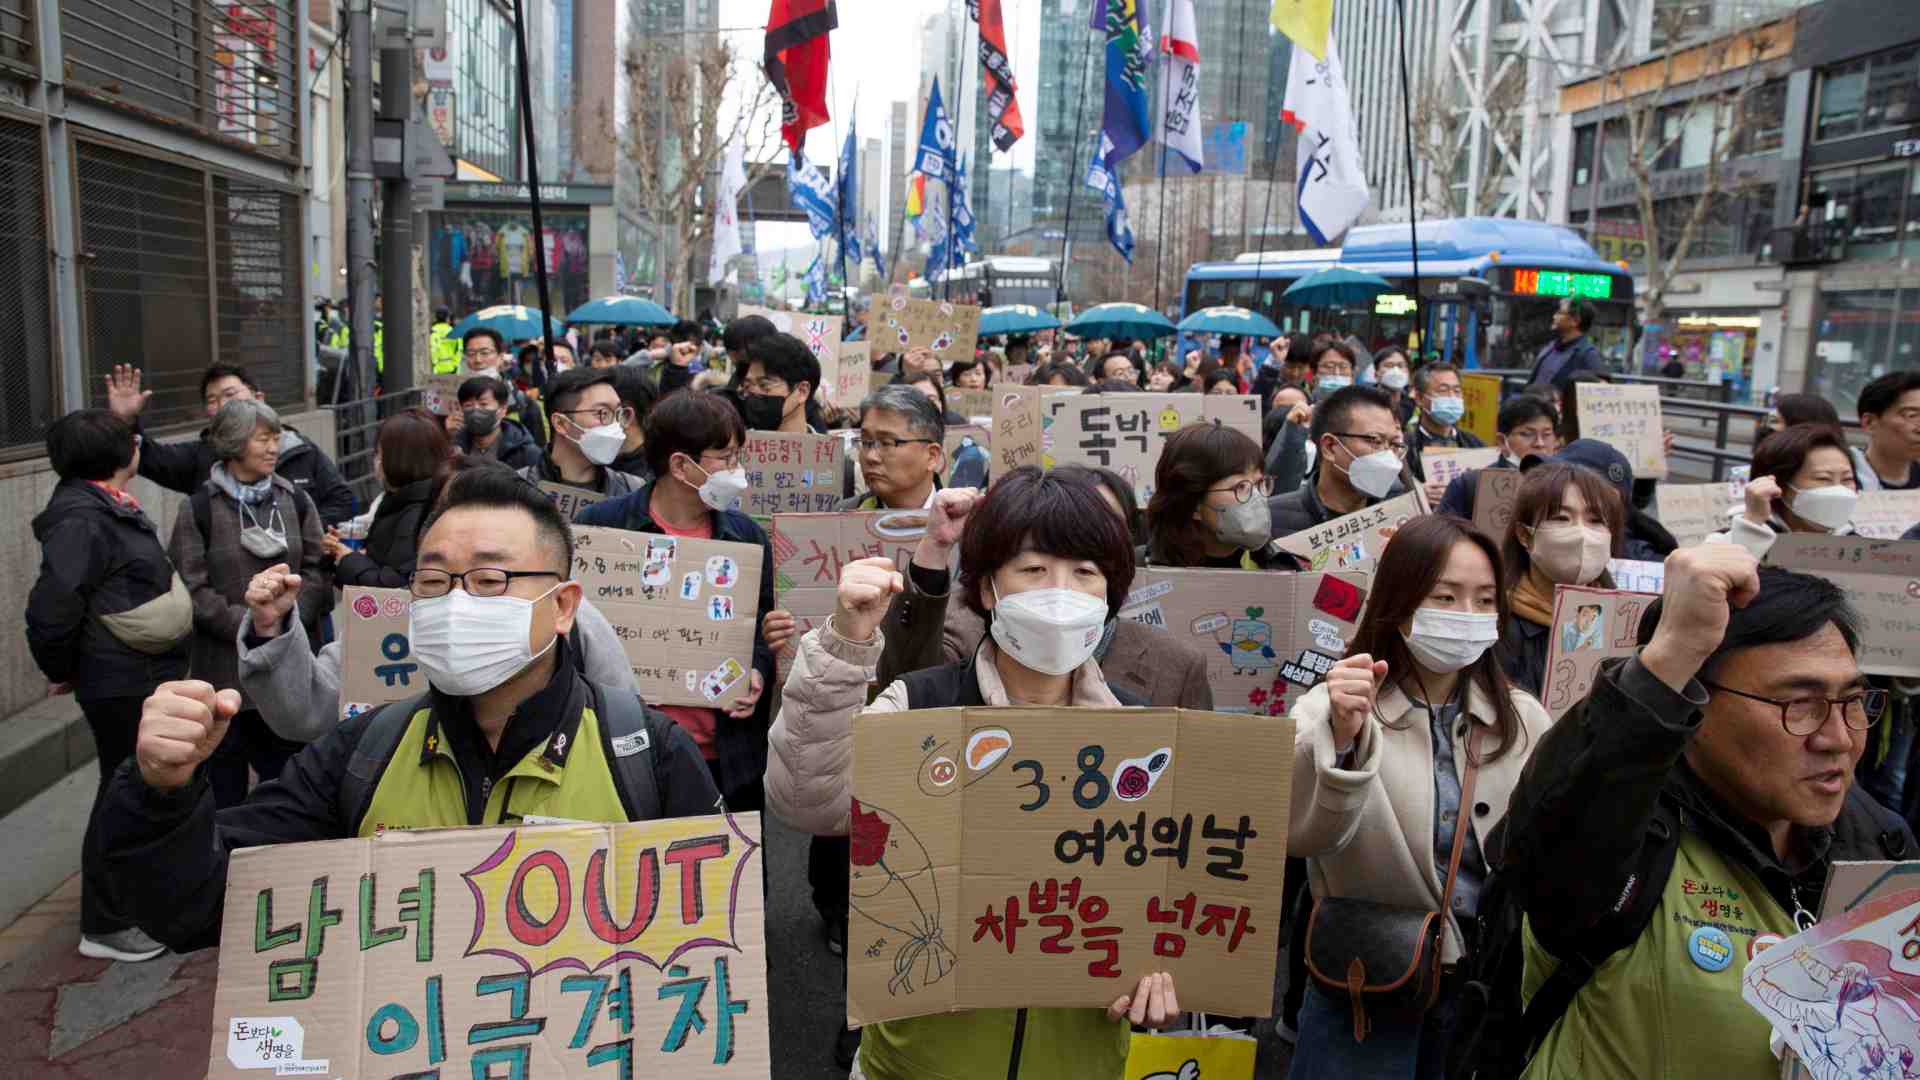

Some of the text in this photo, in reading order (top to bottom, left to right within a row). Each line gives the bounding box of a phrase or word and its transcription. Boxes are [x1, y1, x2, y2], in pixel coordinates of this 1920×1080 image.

[1079, 406, 1151, 466] 독박
[1308, 507, 1389, 550] 보건의료노조
[1053, 810, 1257, 881] 여성의 날
[1681, 879, 1725, 898] 돈보다
[1700, 899, 1743, 921] 생명을
[255, 833, 730, 1003] 남녀 OUT
[972, 875, 1257, 978] 차별을 넘자
[233, 1021, 271, 1041] 돈보다
[255, 1038, 295, 1061] 생명을
